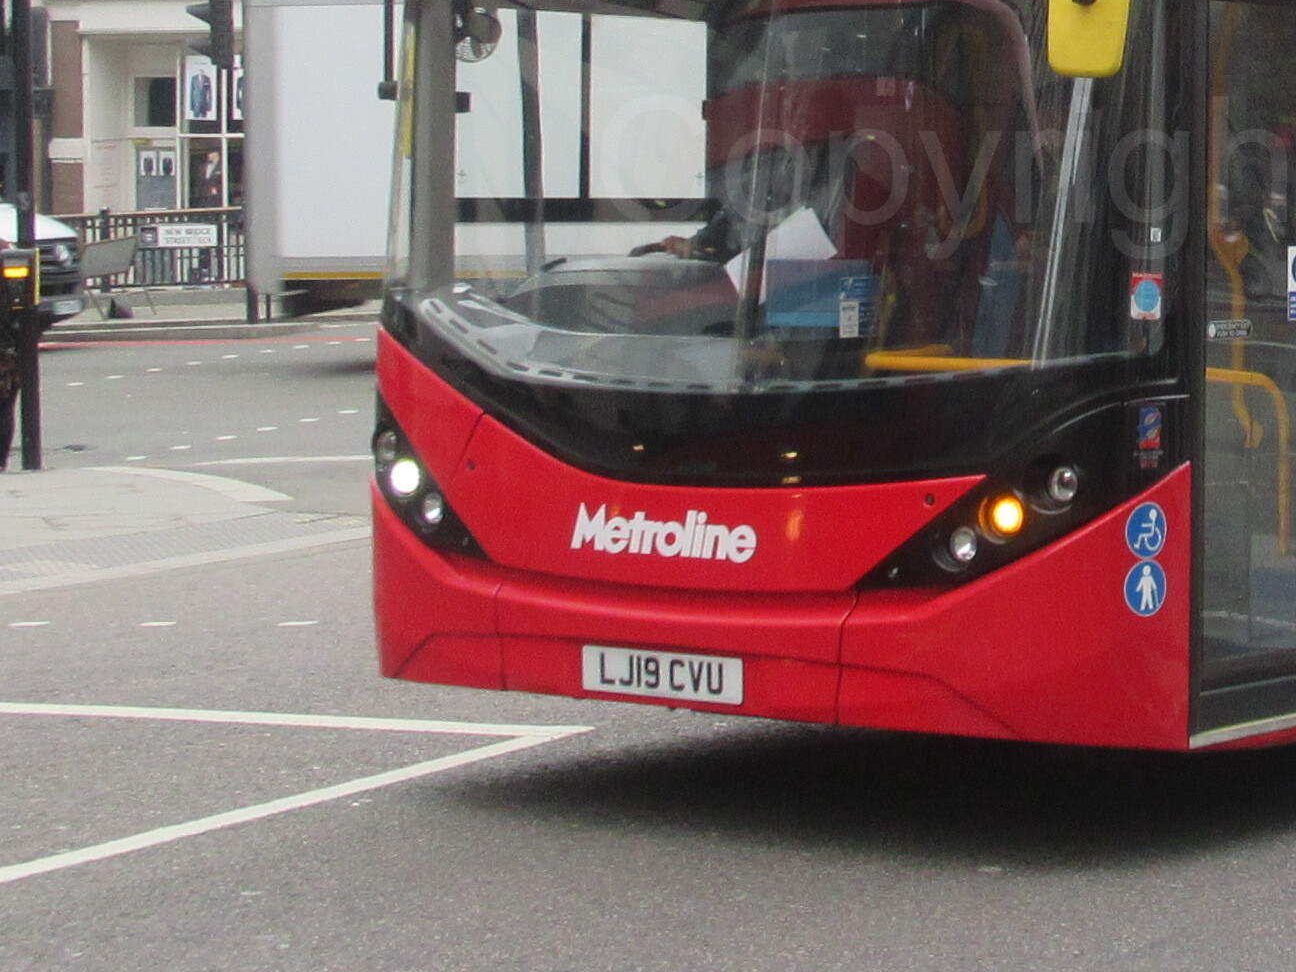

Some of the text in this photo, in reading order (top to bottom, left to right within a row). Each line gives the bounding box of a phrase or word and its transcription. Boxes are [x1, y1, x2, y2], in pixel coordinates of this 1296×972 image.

[570, 501, 758, 564] Metroline
[600, 652, 724, 695] LJ19 CVU
